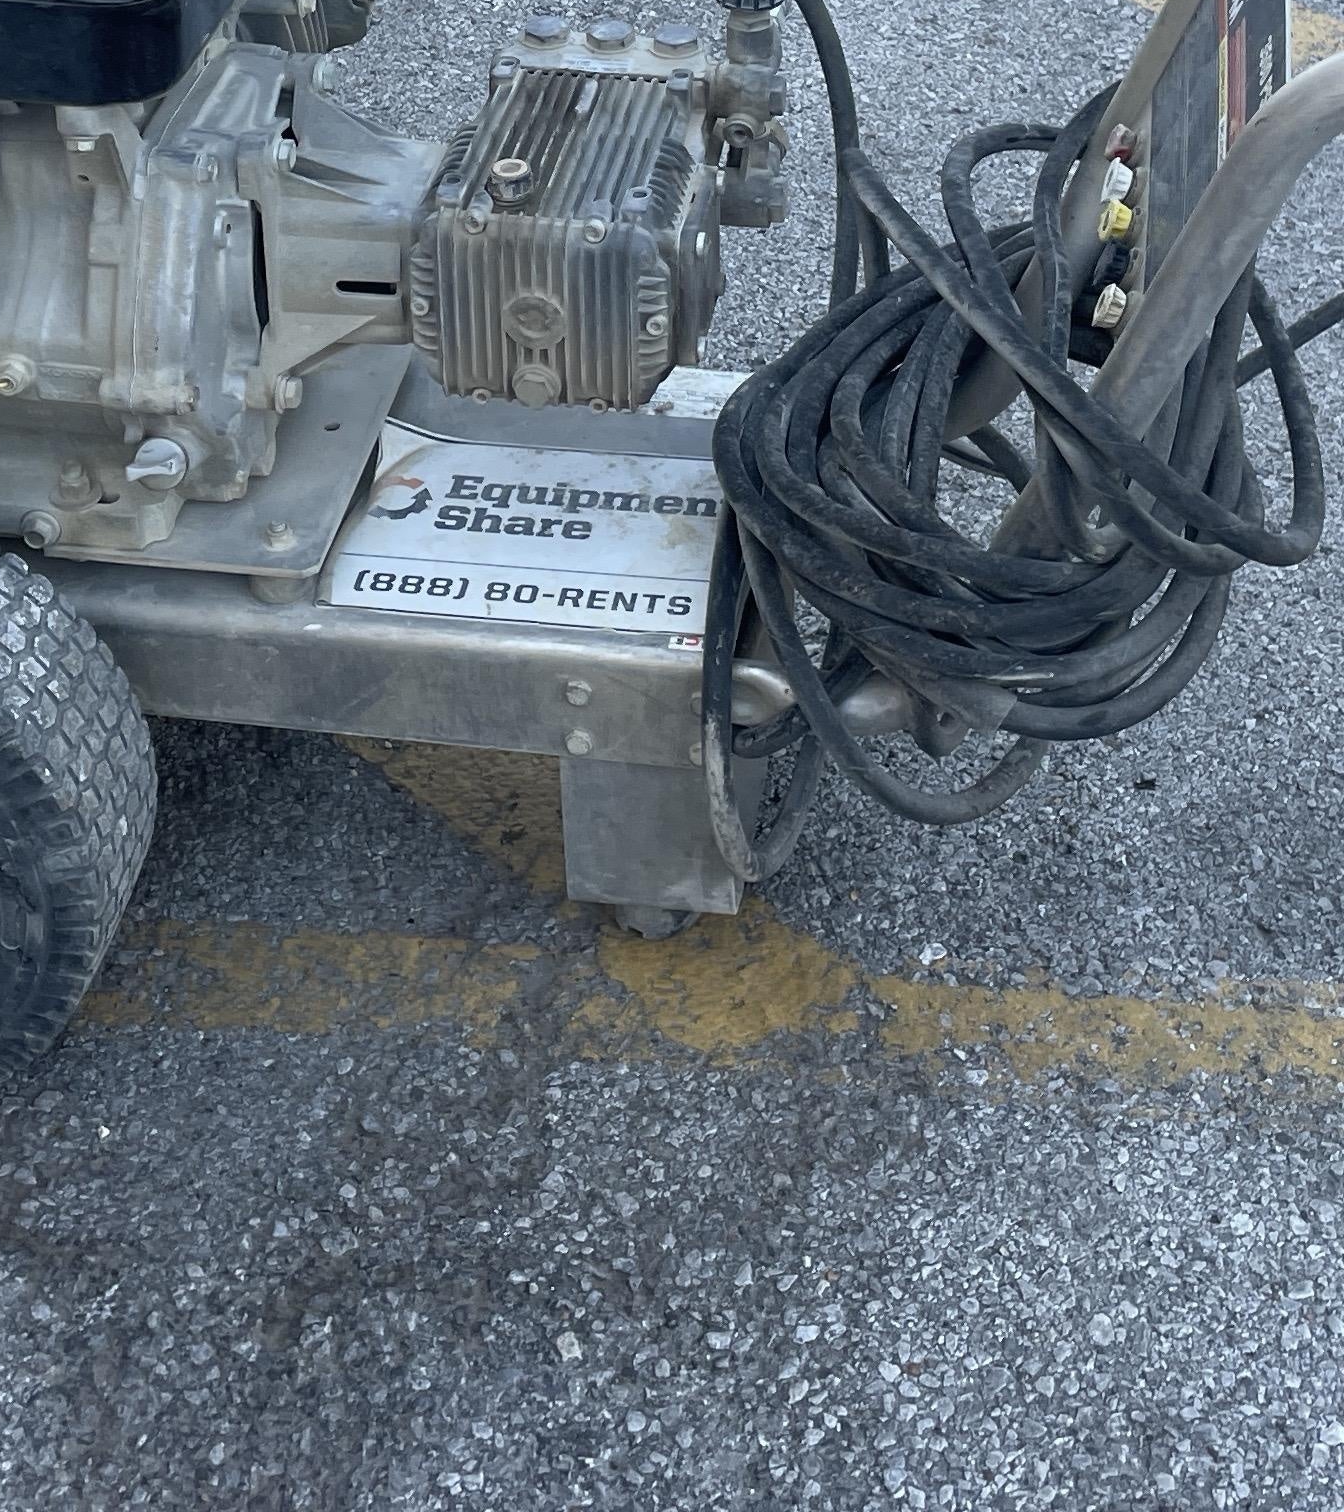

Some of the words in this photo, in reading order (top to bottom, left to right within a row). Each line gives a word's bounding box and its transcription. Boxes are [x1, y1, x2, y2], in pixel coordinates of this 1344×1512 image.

[445, 474, 722, 517] Equipmen
[434, 505, 593, 541] Share
[353, 569, 468, 600] (888)
[483, 582, 693, 617] 80-RENTS
